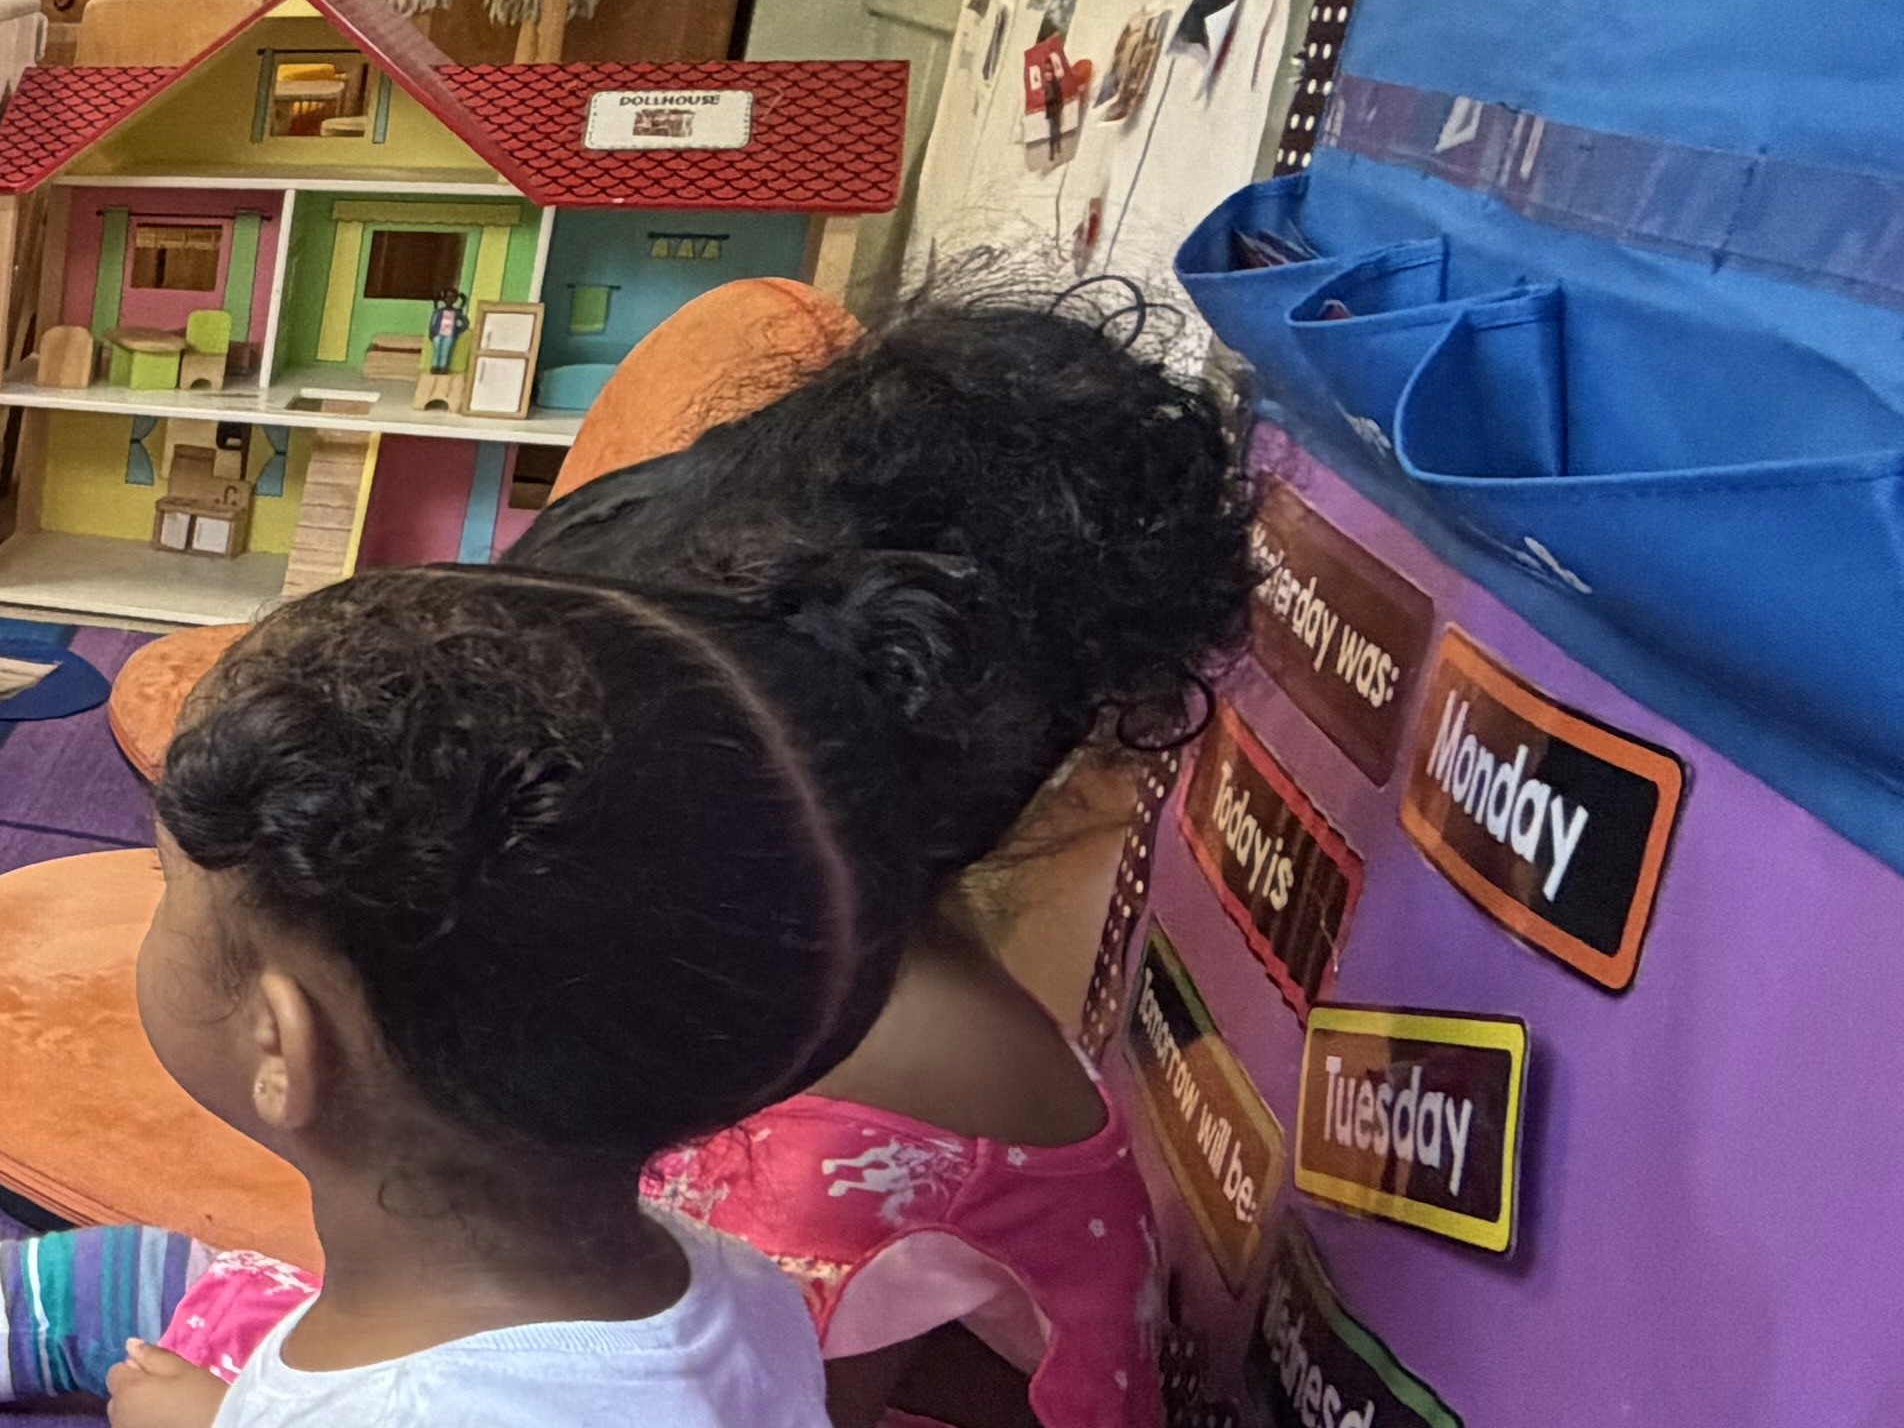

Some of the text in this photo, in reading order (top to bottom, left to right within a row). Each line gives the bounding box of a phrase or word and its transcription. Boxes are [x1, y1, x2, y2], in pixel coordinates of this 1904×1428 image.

[619, 94, 721, 106] DOLLHOUSE
[1337, 624, 1400, 708] was:
[1214, 761, 1294, 911] Today is
[1425, 689, 1589, 902] Monday
[1197, 1103, 1232, 1180] will
[1223, 1140, 1256, 1223] be:
[1322, 1055, 1473, 1197] Tuesday
